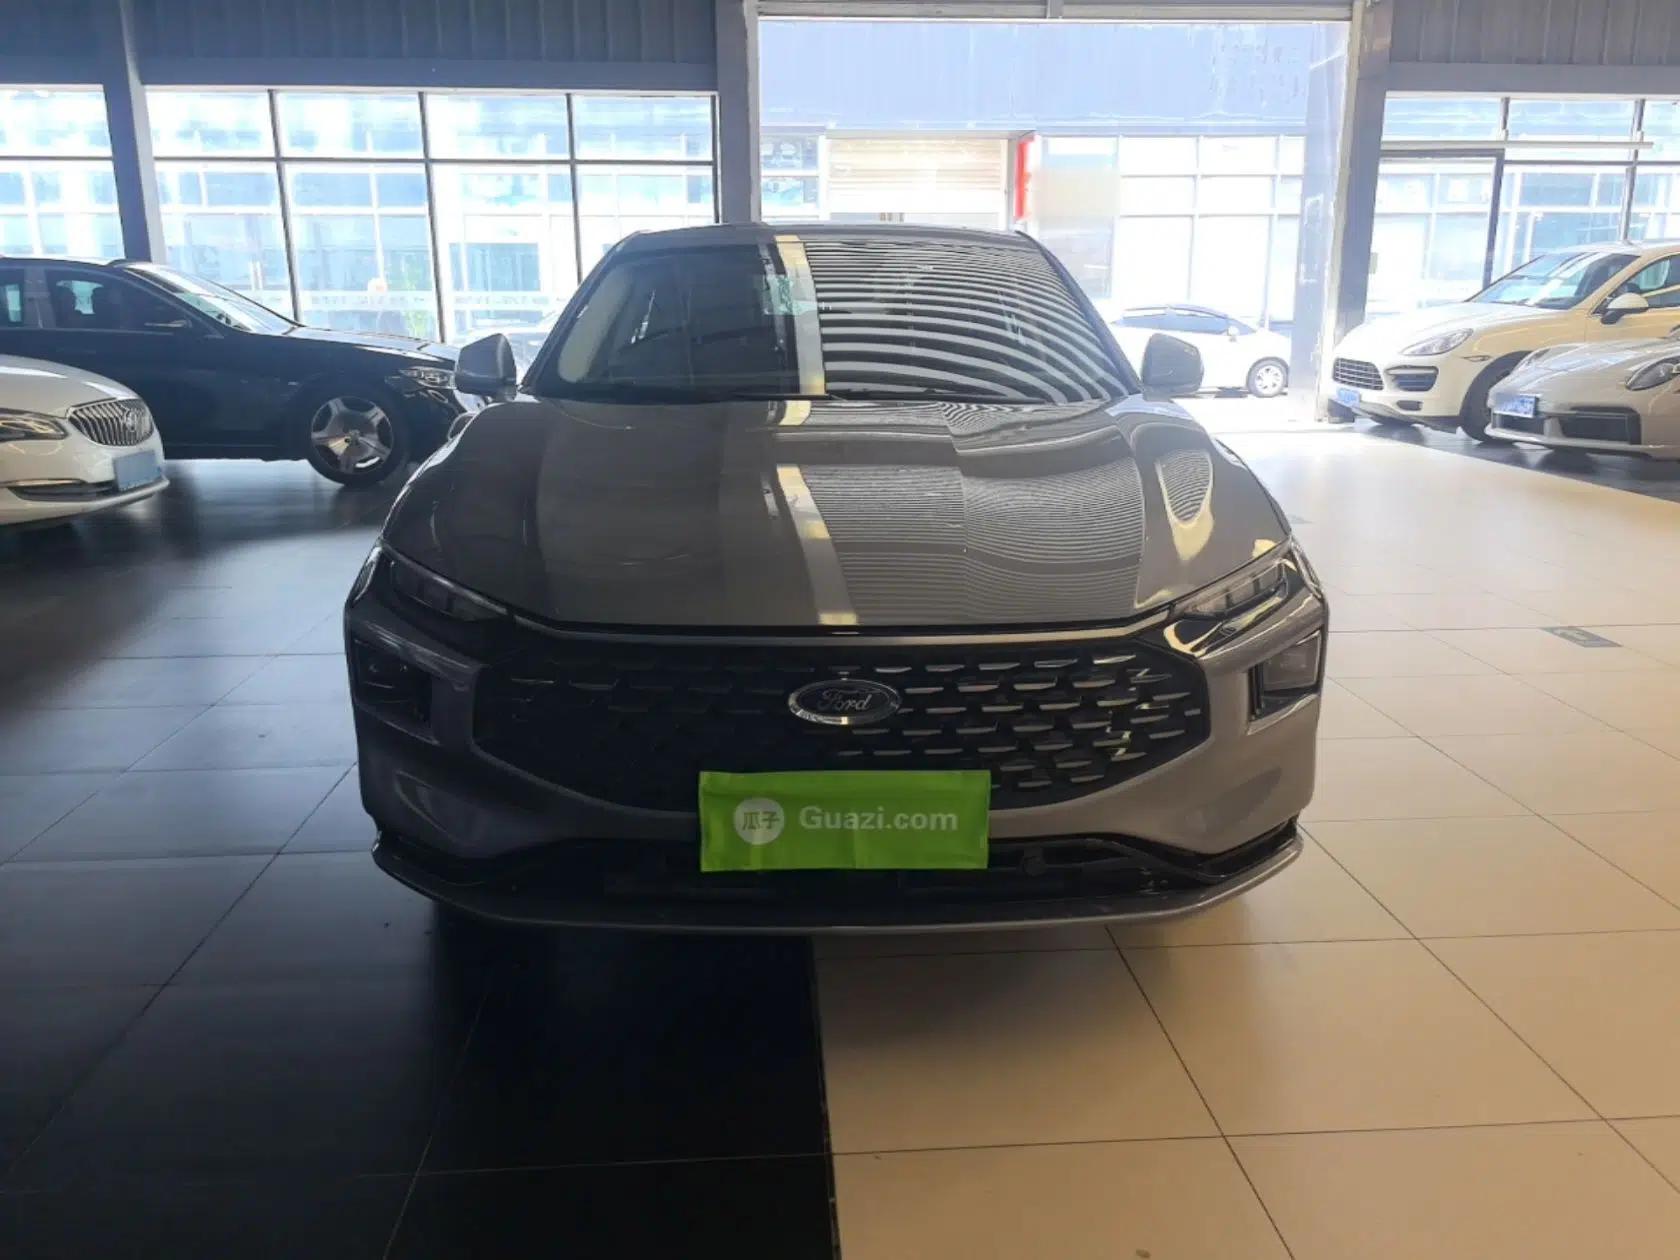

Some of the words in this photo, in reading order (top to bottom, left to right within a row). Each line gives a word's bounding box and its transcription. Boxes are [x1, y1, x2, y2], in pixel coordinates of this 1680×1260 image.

[817, 688, 877, 711] Ford
[742, 811, 780, 831] 瓜子
[799, 805, 958, 831] Guazi.com
